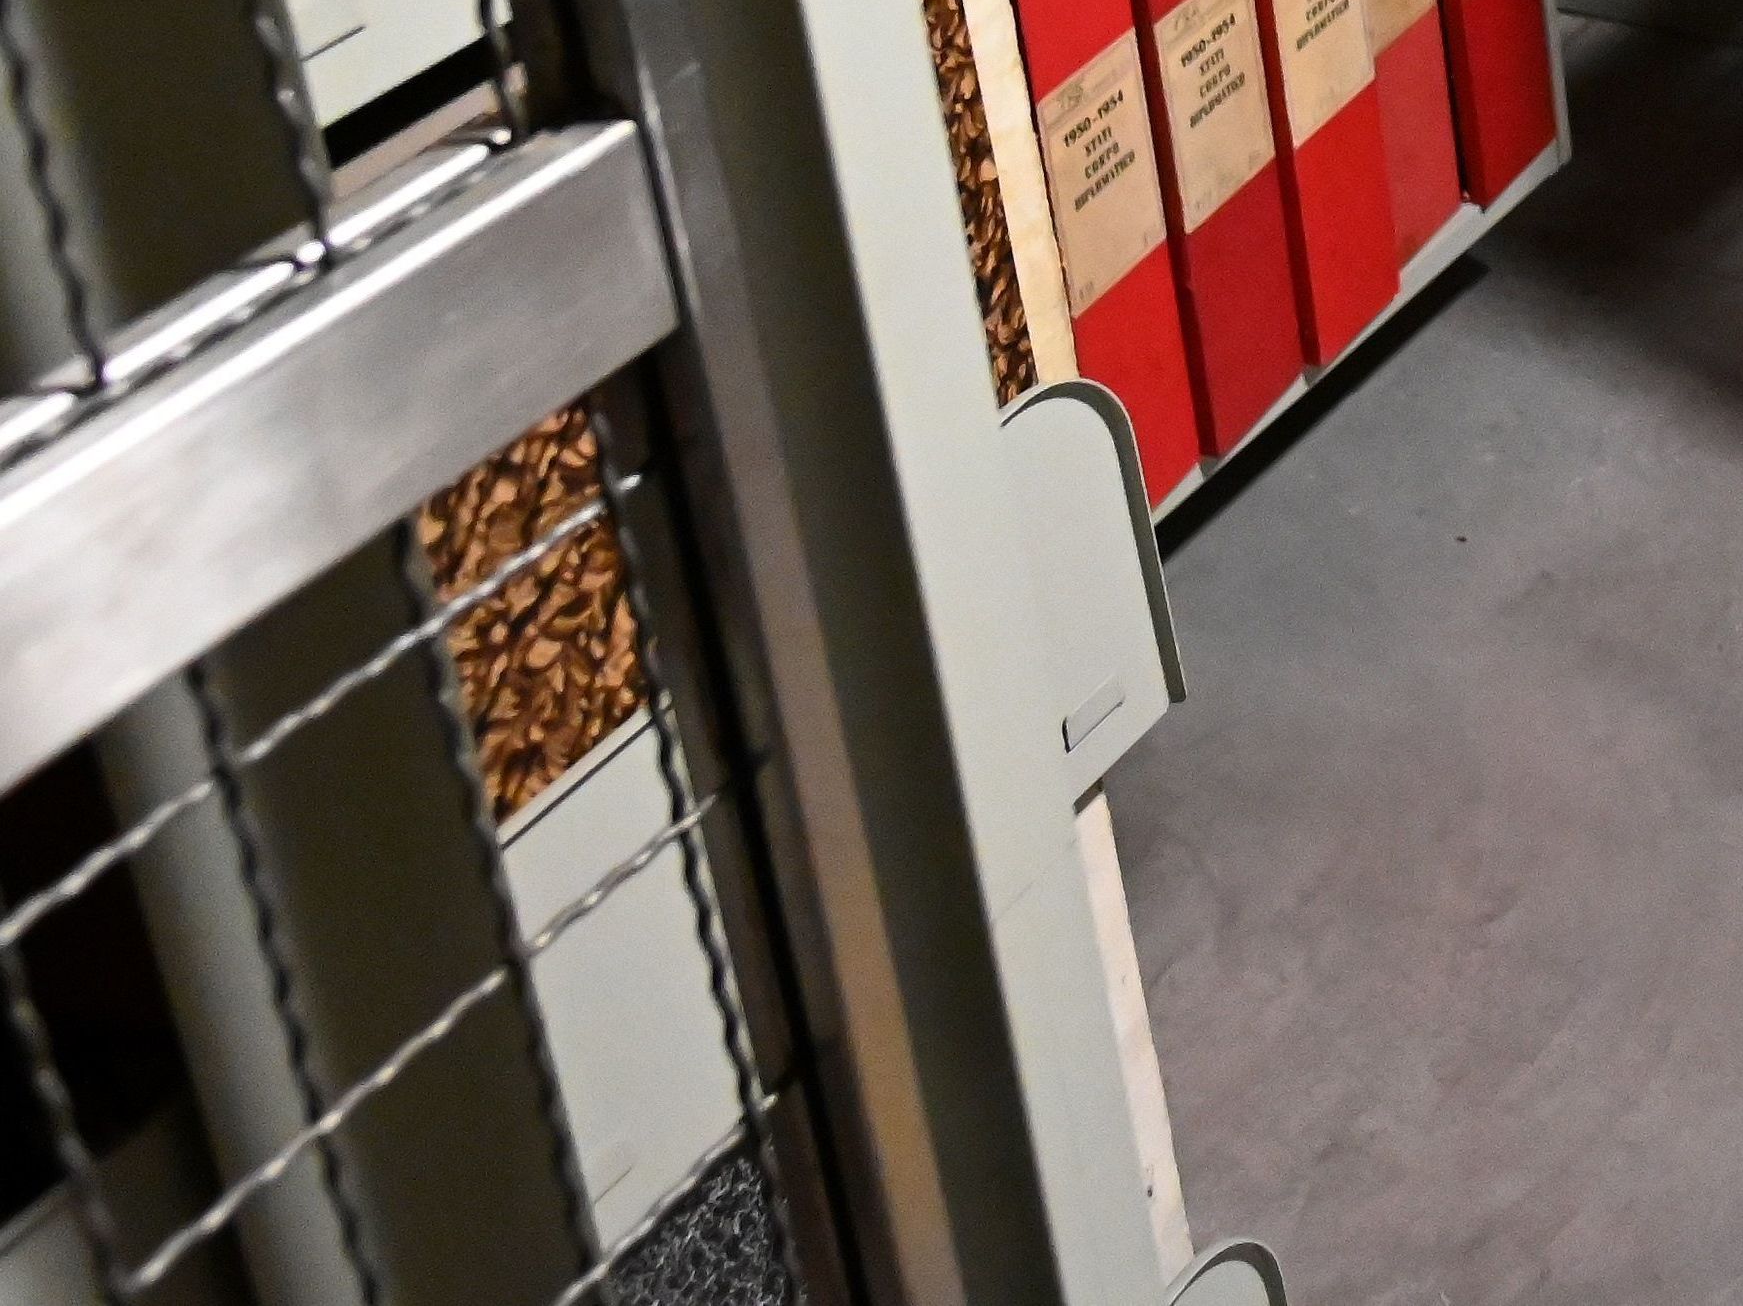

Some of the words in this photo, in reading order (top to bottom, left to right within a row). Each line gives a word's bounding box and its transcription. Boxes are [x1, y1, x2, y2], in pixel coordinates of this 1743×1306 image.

[1063, 88, 1124, 148] 1950-1954
[1084, 126, 1113, 158] STATI
[1074, 148, 1137, 214] DIPLOMATICO
[1085, 141, 1120, 181] CORPO
